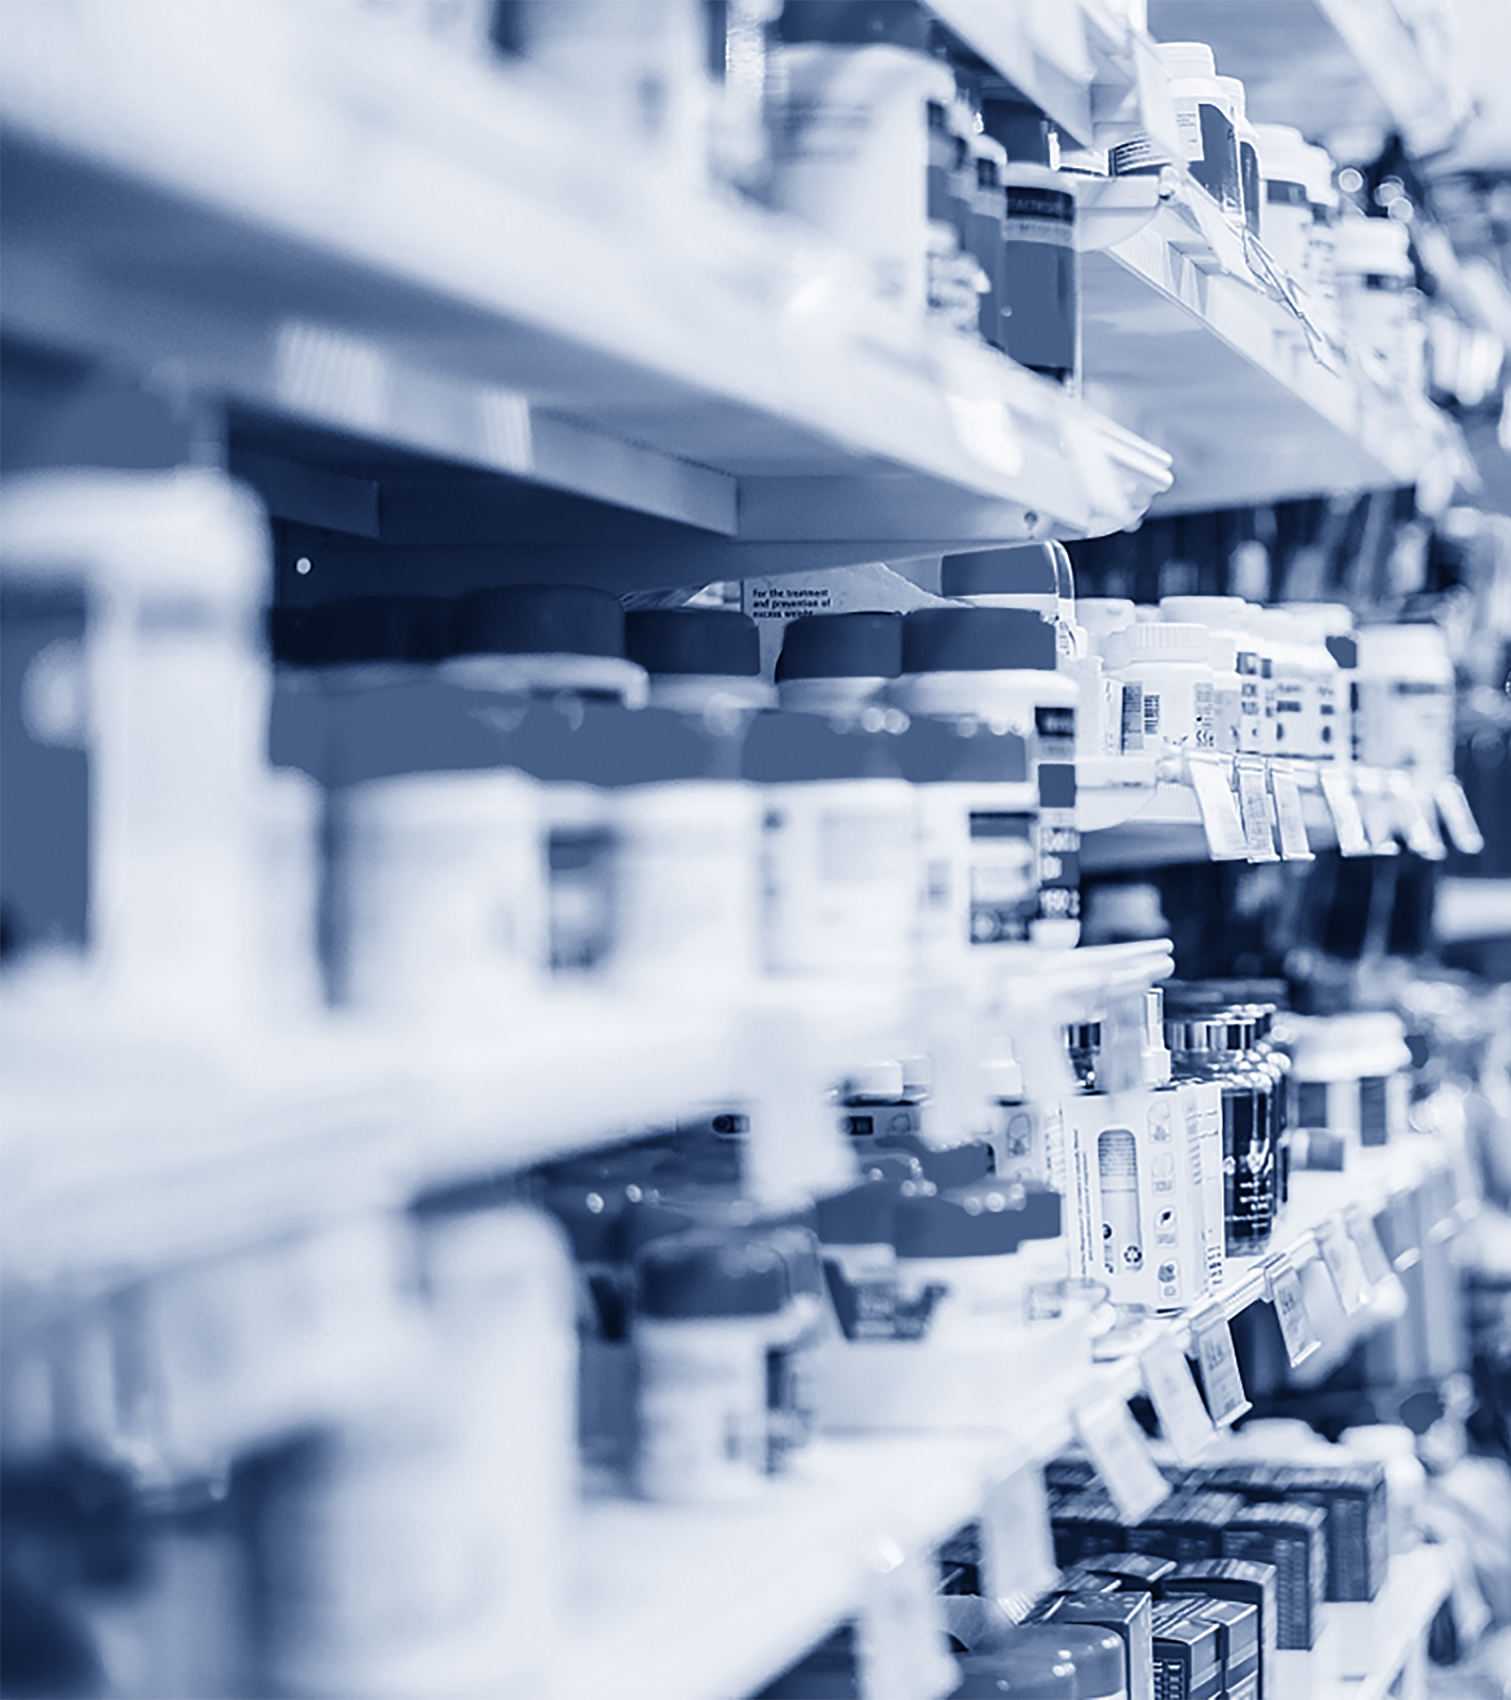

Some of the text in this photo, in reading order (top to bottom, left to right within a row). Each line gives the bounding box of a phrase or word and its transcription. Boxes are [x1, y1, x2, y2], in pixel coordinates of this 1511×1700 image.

[769, 588, 783, 598] the
[785, 589, 829, 598] treatment
[753, 598, 831, 610] and prevention of
